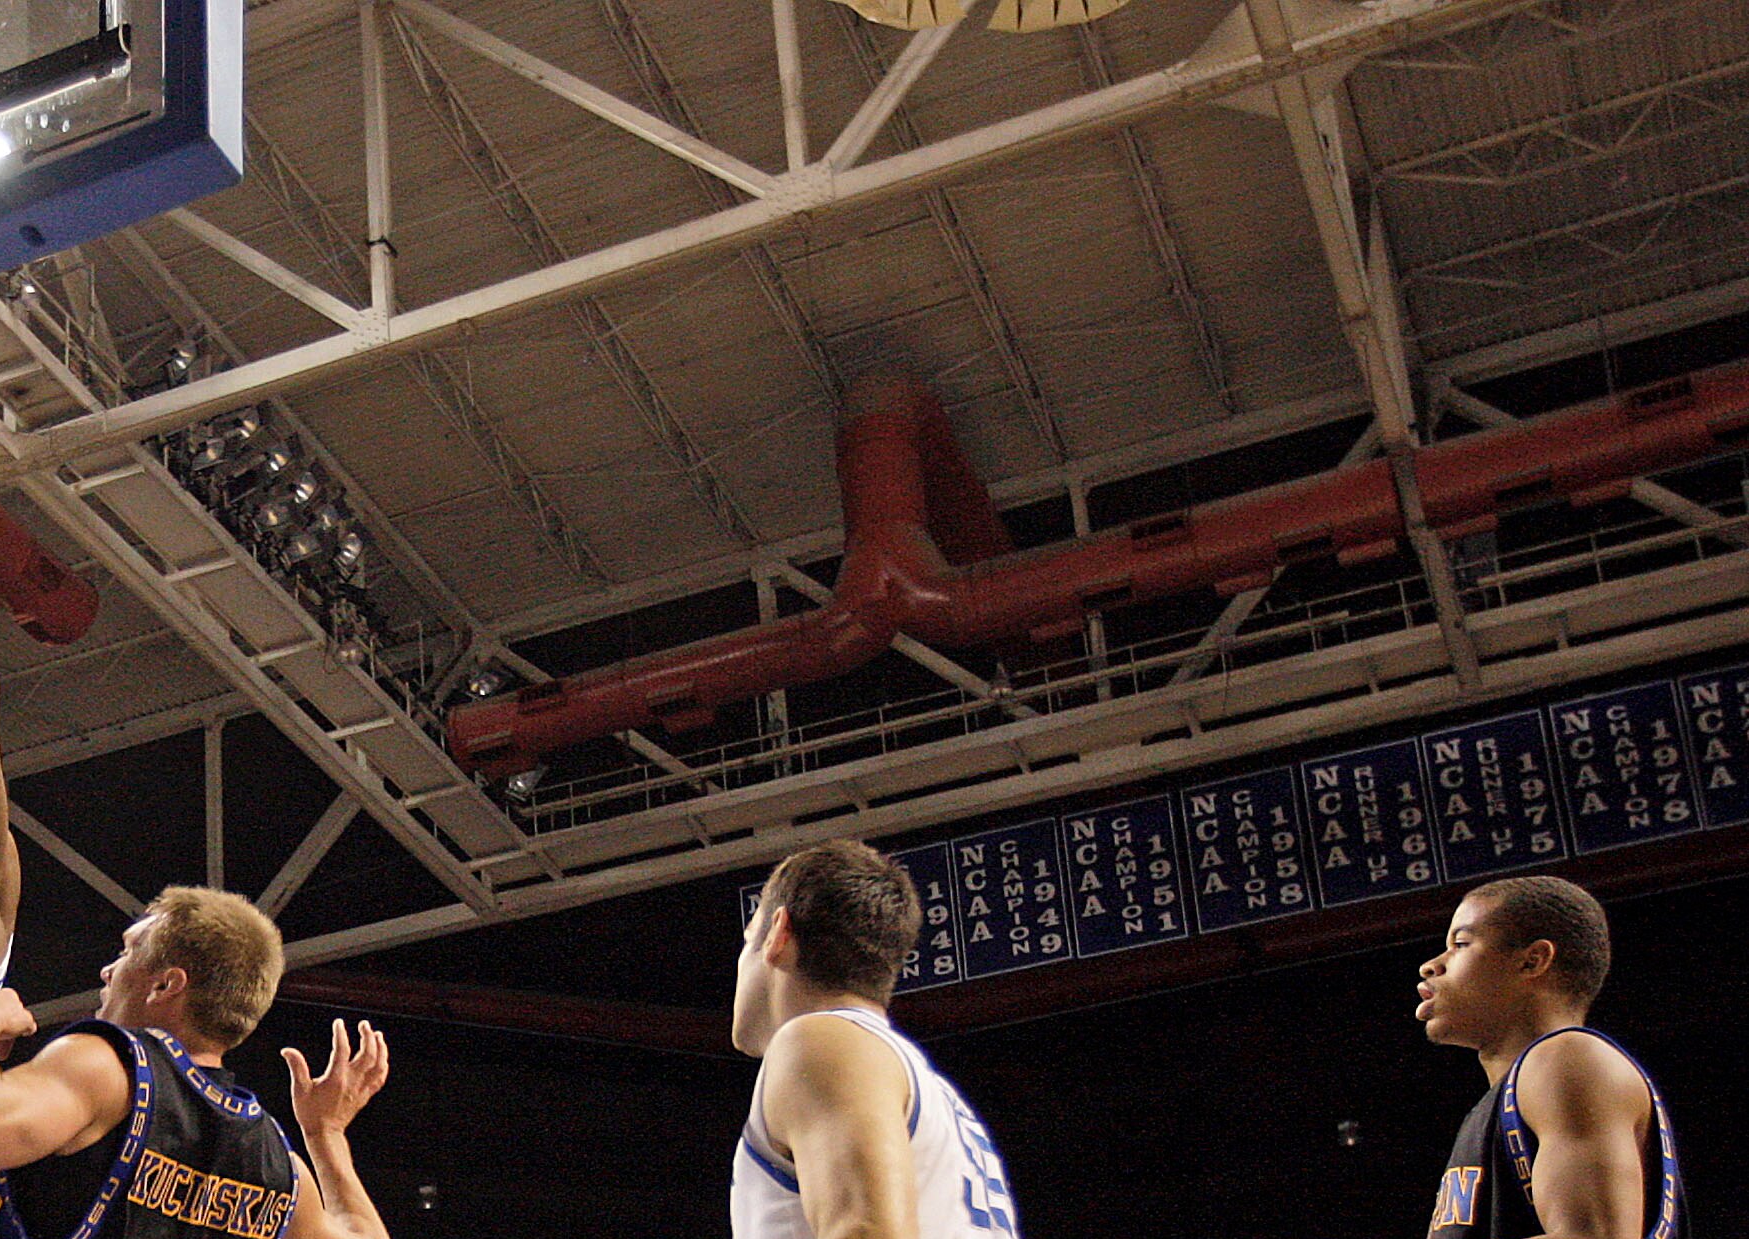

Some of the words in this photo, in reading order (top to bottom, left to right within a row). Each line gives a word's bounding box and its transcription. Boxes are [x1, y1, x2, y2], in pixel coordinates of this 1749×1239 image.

[1560, 708, 1610, 816] NCAA
[1605, 704, 1651, 829] CHAMPION
[1652, 717, 1691, 823] 1978
[1688, 681, 1738, 790] NCAA
[1311, 764, 1351, 870] NCAA
[1396, 781, 1431, 883] 1966
[1431, 738, 1476, 844] NCAA
[1517, 751, 1556, 854] 1975
[960, 843, 995, 943] NCAA
[1069, 817, 1107, 918] NCAA
[1110, 816, 1144, 935] CHAMPION
[1147, 833, 1178, 933] 1951
[1190, 792, 1234, 896] NCAA
[1231, 789, 1268, 910] CHAMPION
[1269, 804, 1304, 906] 1958
[926, 880, 957, 976] 1948
[999, 839, 1032, 957] CHAMPION
[1033, 858, 1064, 955] 1949
